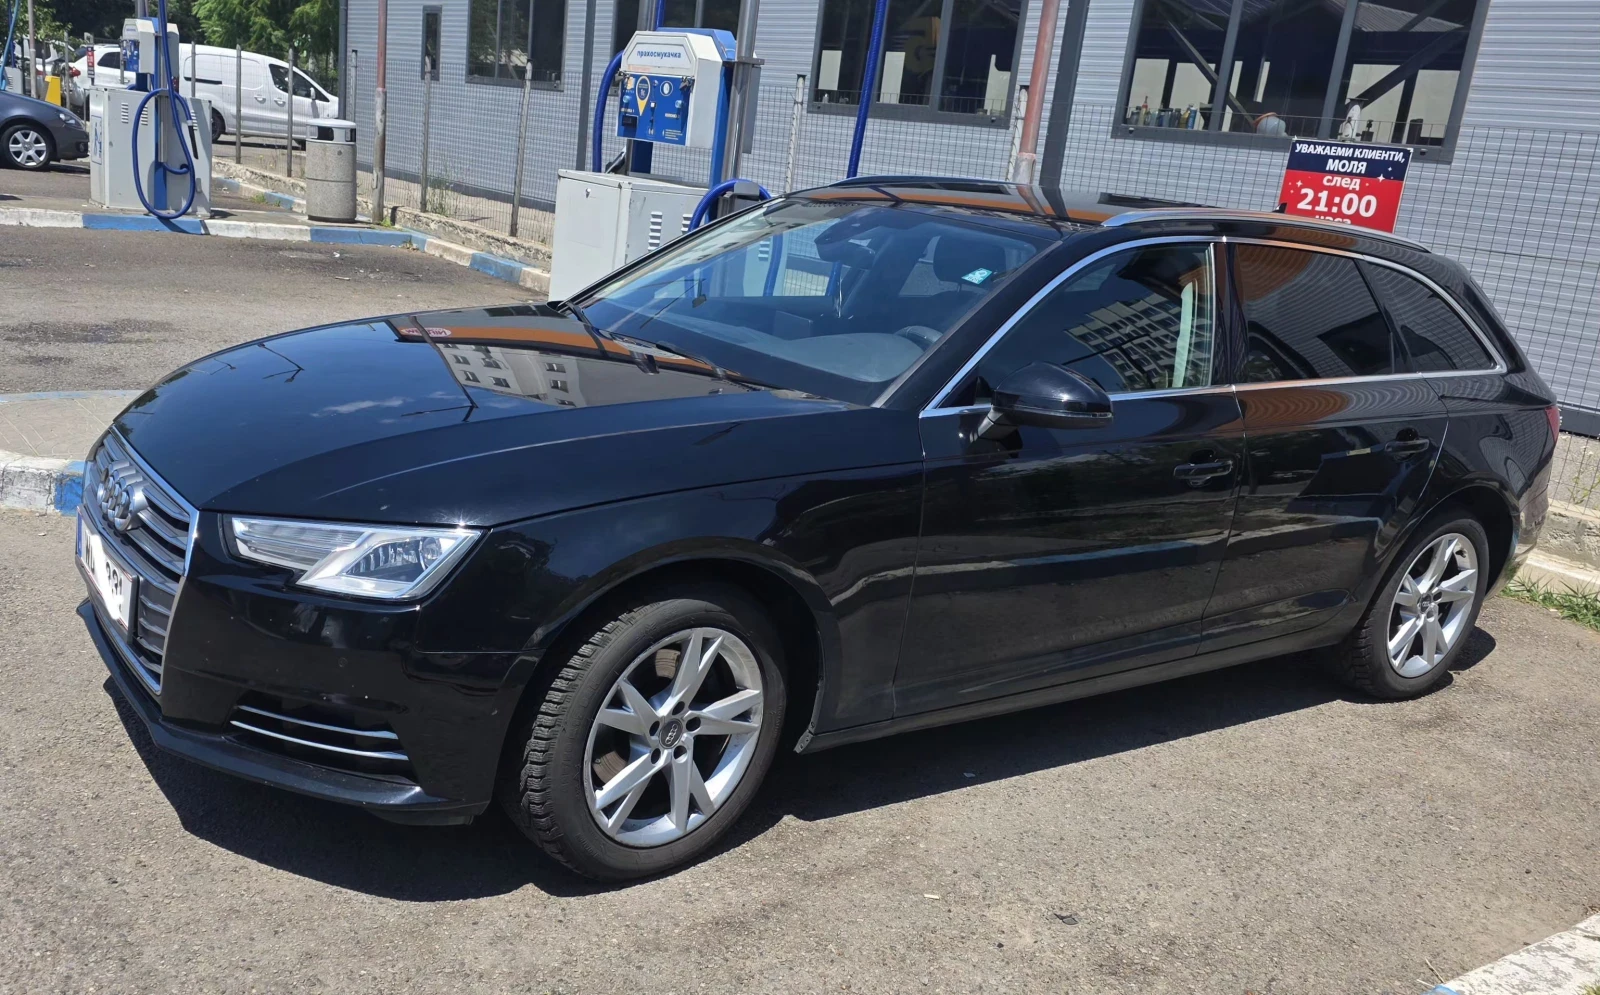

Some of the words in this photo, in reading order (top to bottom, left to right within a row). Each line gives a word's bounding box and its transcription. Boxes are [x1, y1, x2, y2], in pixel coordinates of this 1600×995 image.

[636, 50, 682, 60] прахосмукачка
[1295, 143, 1353, 158] УВАЖАЕМИ
[1353, 148, 1405, 163] КЛИЕНТИ,
[1325, 158, 1367, 174] МОЛЯ
[1322, 175, 1361, 191] след
[1296, 188, 1377, 217] 21:00
